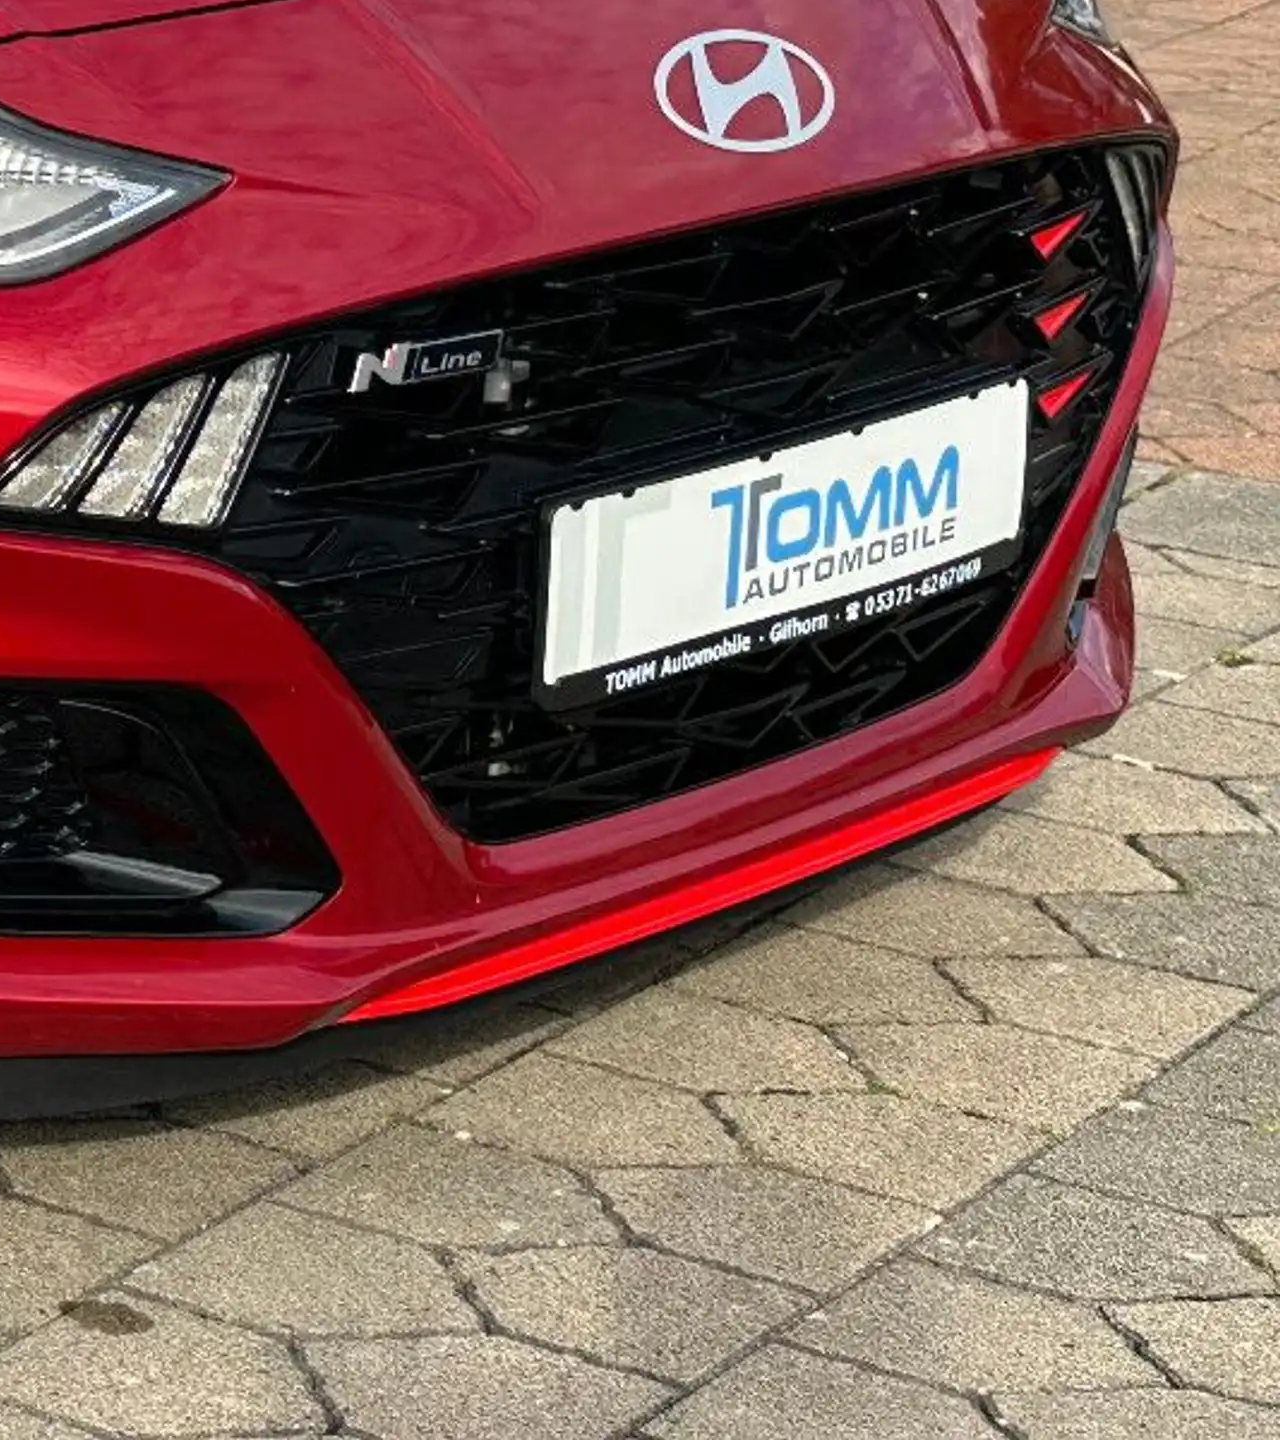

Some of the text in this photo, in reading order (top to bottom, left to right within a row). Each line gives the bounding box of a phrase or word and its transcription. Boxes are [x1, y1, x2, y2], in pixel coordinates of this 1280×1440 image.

[419, 349, 483, 375] Line
[740, 516, 958, 606] AUTOMOBILE
[604, 659, 657, 696] TOMM
[659, 632, 752, 679] Automobile
